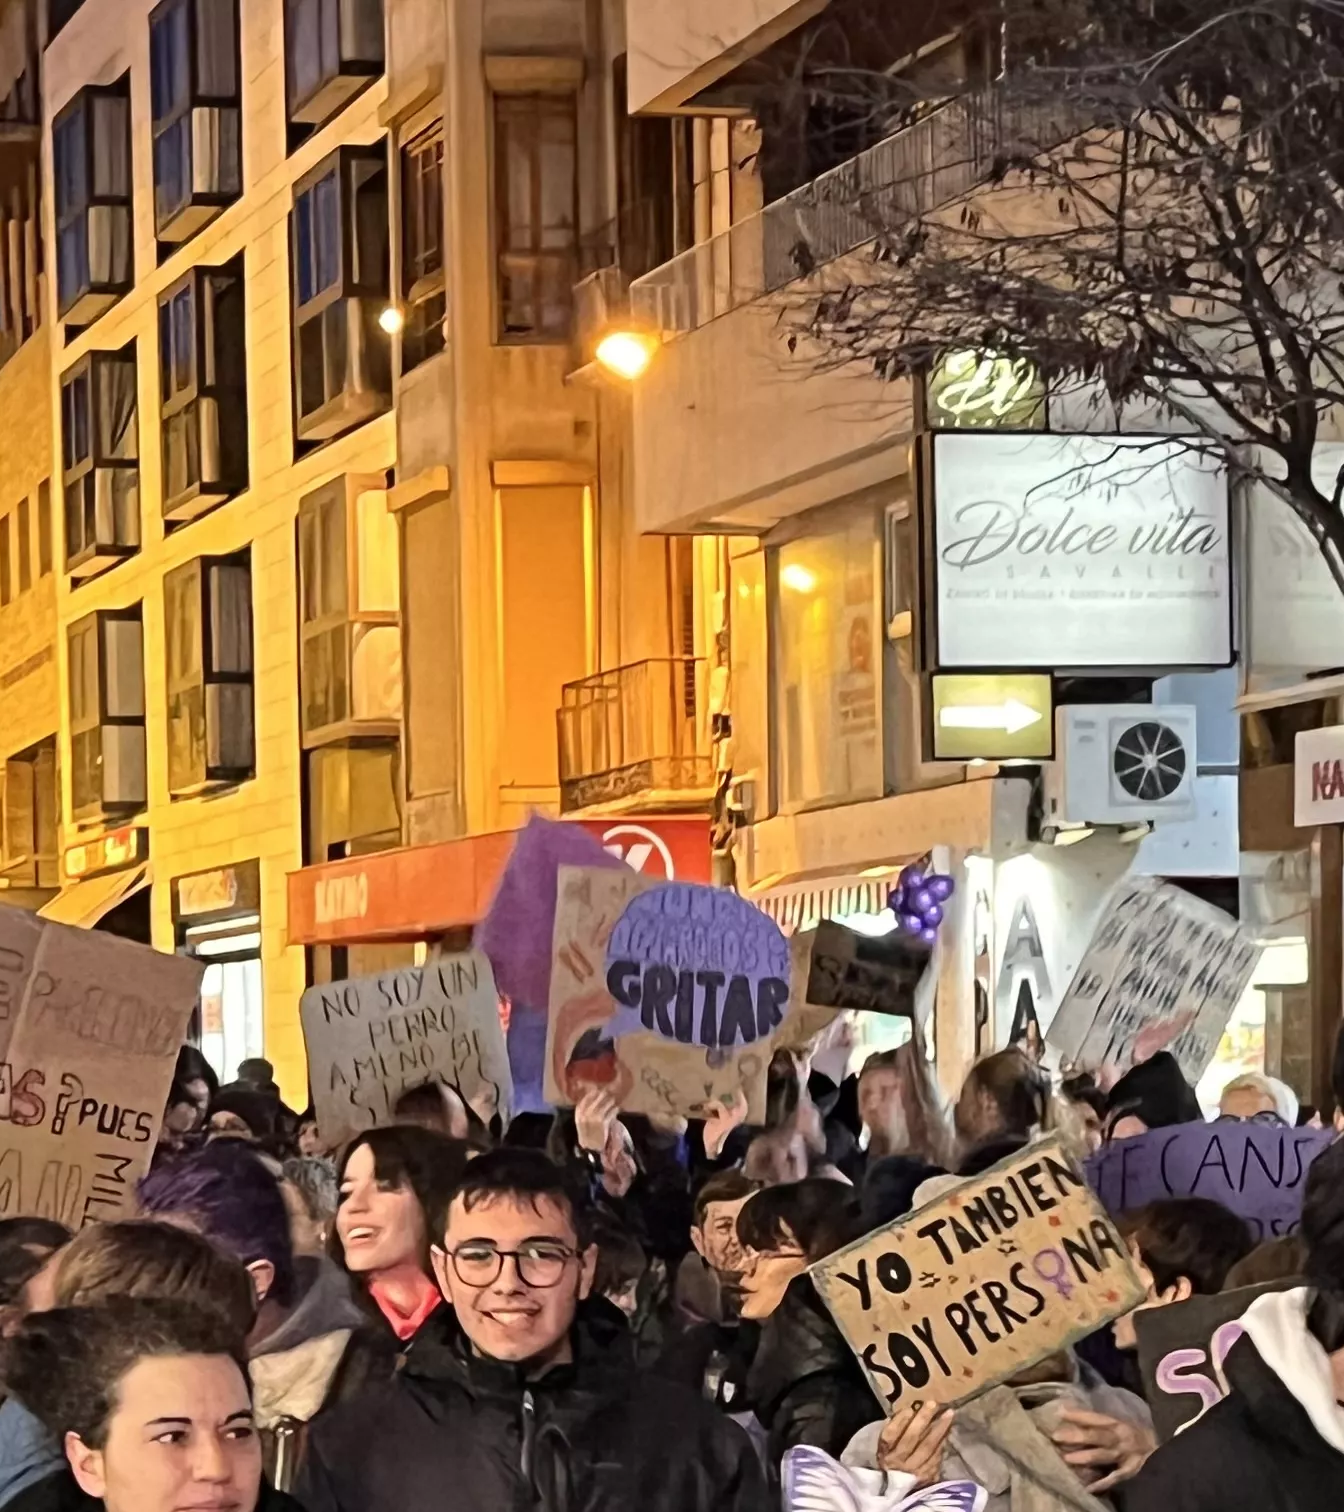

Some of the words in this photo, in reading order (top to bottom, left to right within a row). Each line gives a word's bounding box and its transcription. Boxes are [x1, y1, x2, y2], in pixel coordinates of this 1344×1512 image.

[942, 500, 1118, 571] Dolce
[1128, 506, 1221, 555] vita
[321, 986, 360, 1024] NO
[377, 968, 424, 1010] SOY
[438, 959, 478, 1000] UN
[607, 961, 789, 1049] GRITAR
[369, 1004, 456, 1051] PERRO
[78, 1097, 153, 1142] PUES
[836, 1252, 912, 1311] YO
[917, 1156, 1084, 1265] TAMBIEN
[860, 1317, 952, 1403] SOY
